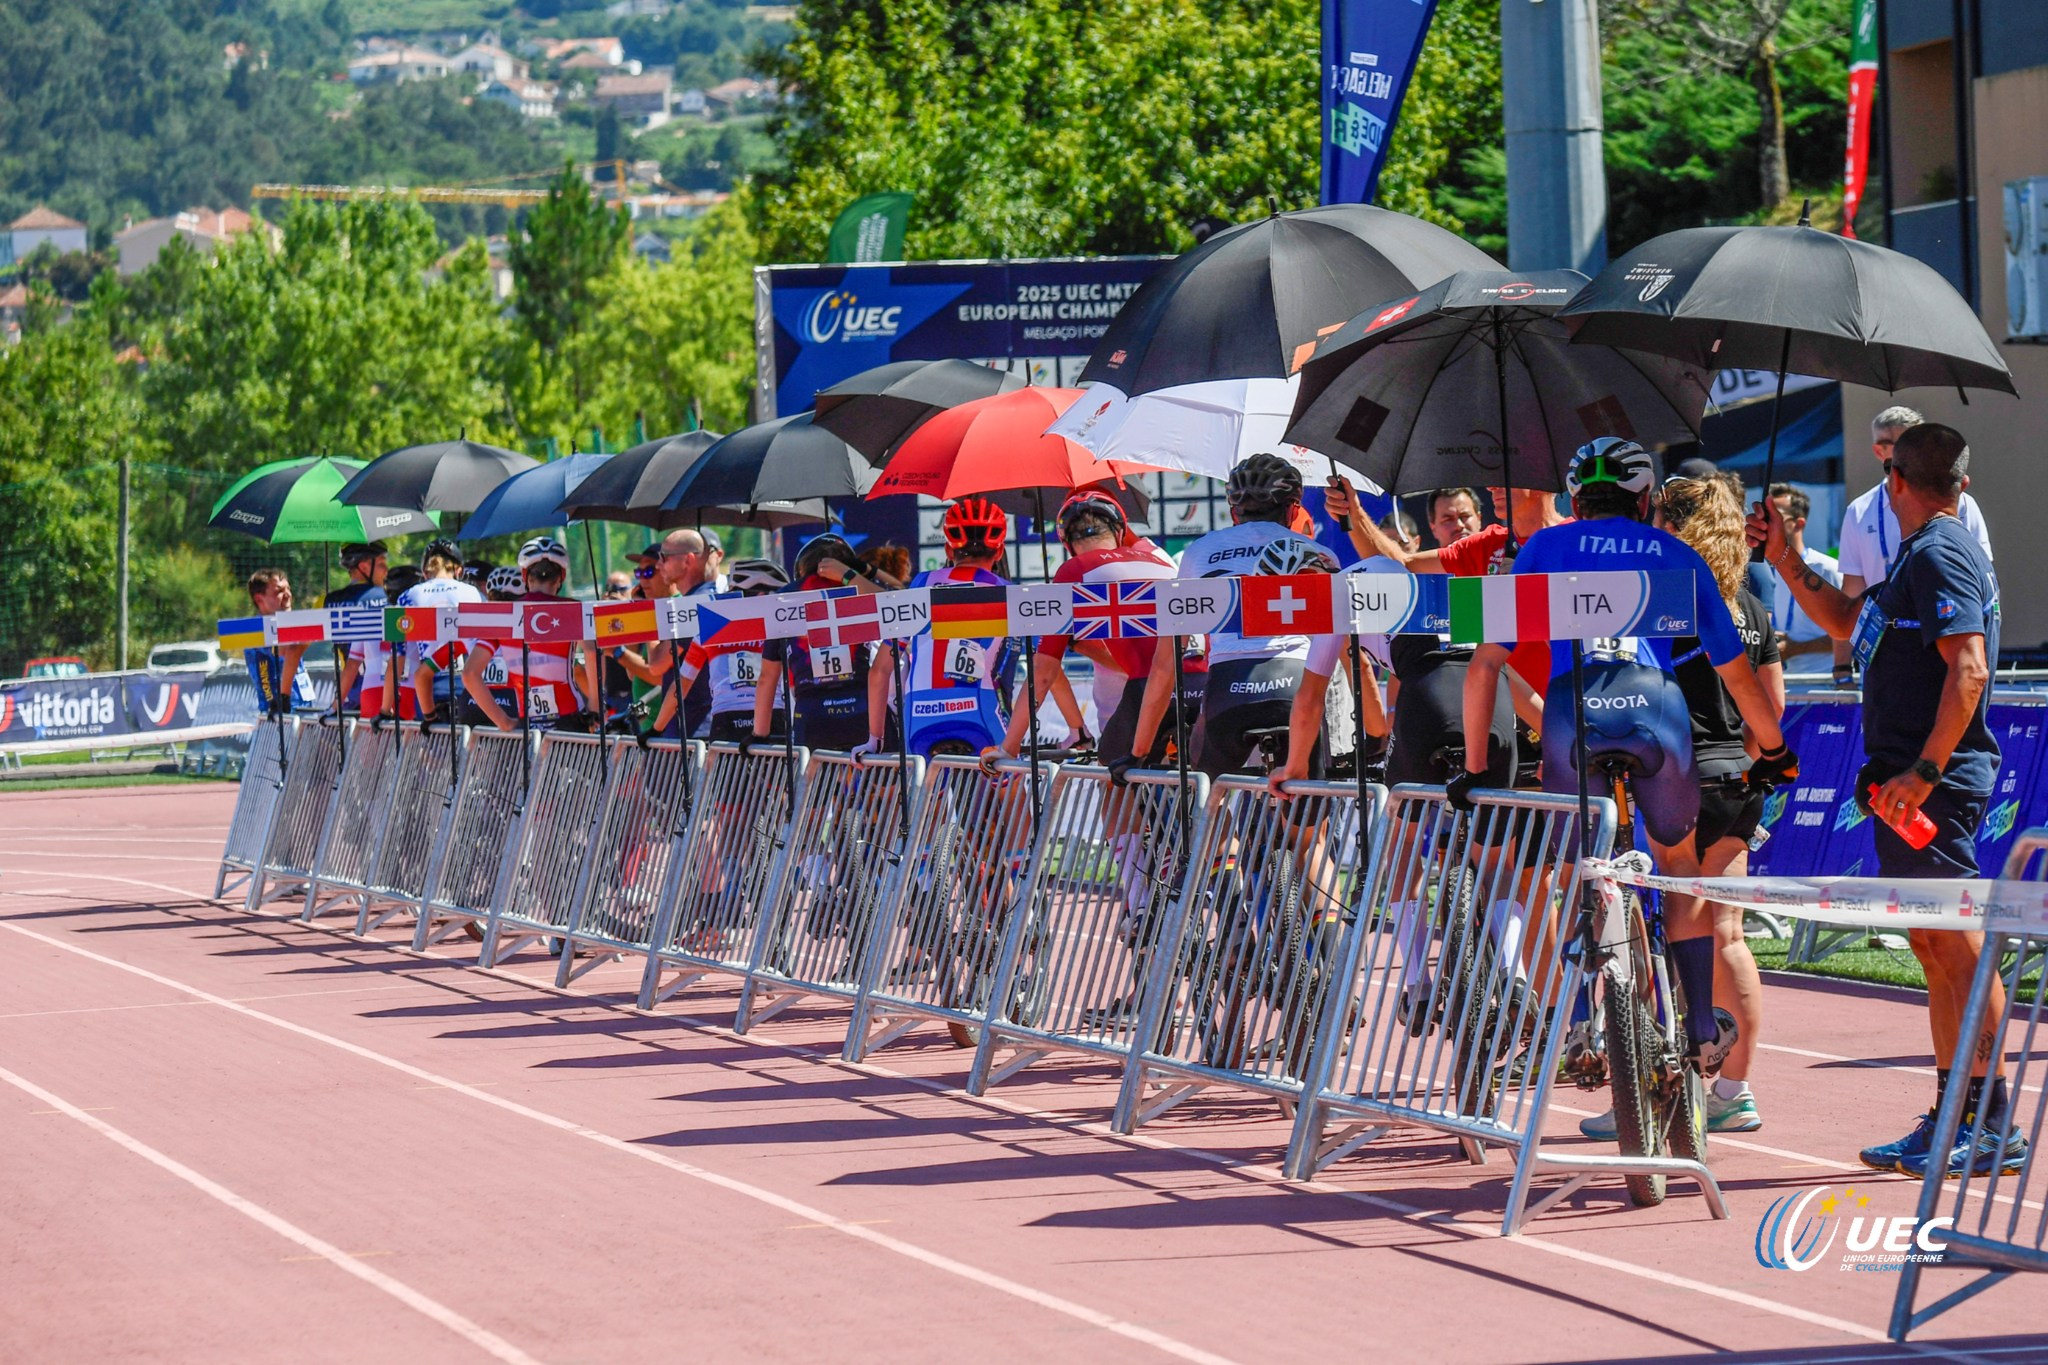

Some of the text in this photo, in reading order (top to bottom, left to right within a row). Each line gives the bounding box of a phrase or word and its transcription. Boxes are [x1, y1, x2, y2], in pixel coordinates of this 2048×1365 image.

[1017, 285, 1061, 302] 2025
[1065, 283, 1102, 301] UEC
[843, 305, 903, 331] UEC
[957, 303, 1054, 322] EUROPEAN
[1023, 325, 1079, 342] MELGAÇO
[1208, 545, 1263, 565] GERM
[1579, 535, 1663, 556] ITALIA
[1018, 600, 1063, 618] GER
[1168, 597, 1216, 616] GBR
[1351, 592, 1388, 612] SUI
[1572, 593, 1613, 615] ITA
[666, 608, 698, 624] ESP
[881, 602, 928, 624] DEN
[1668, 619, 1690, 630] UEC
[737, 658, 755, 680] 8B
[820, 650, 842, 675] 7B
[955, 646, 976, 675] 6B
[259, 660, 274, 702] UKRAINE
[1229, 676, 1294, 694] GERMANY
[17, 687, 115, 728] vittoria
[533, 694, 550, 714] 9B
